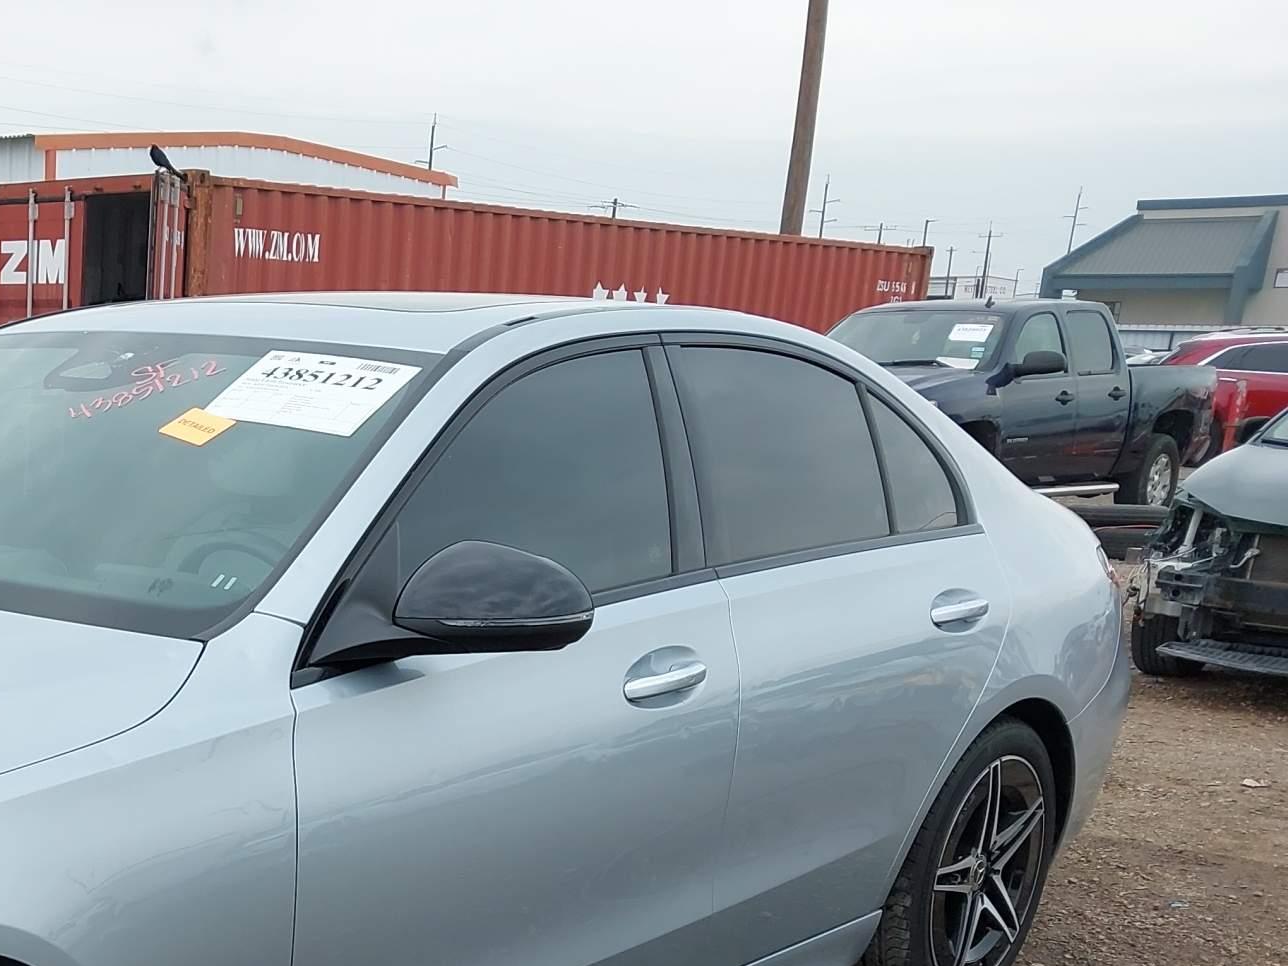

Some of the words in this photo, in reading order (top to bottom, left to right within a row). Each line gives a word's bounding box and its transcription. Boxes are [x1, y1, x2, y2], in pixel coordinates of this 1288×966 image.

[0, 238, 66, 285] ZIM
[69, 361, 227, 418] 43851212
[262, 366, 383, 390] 43851212
